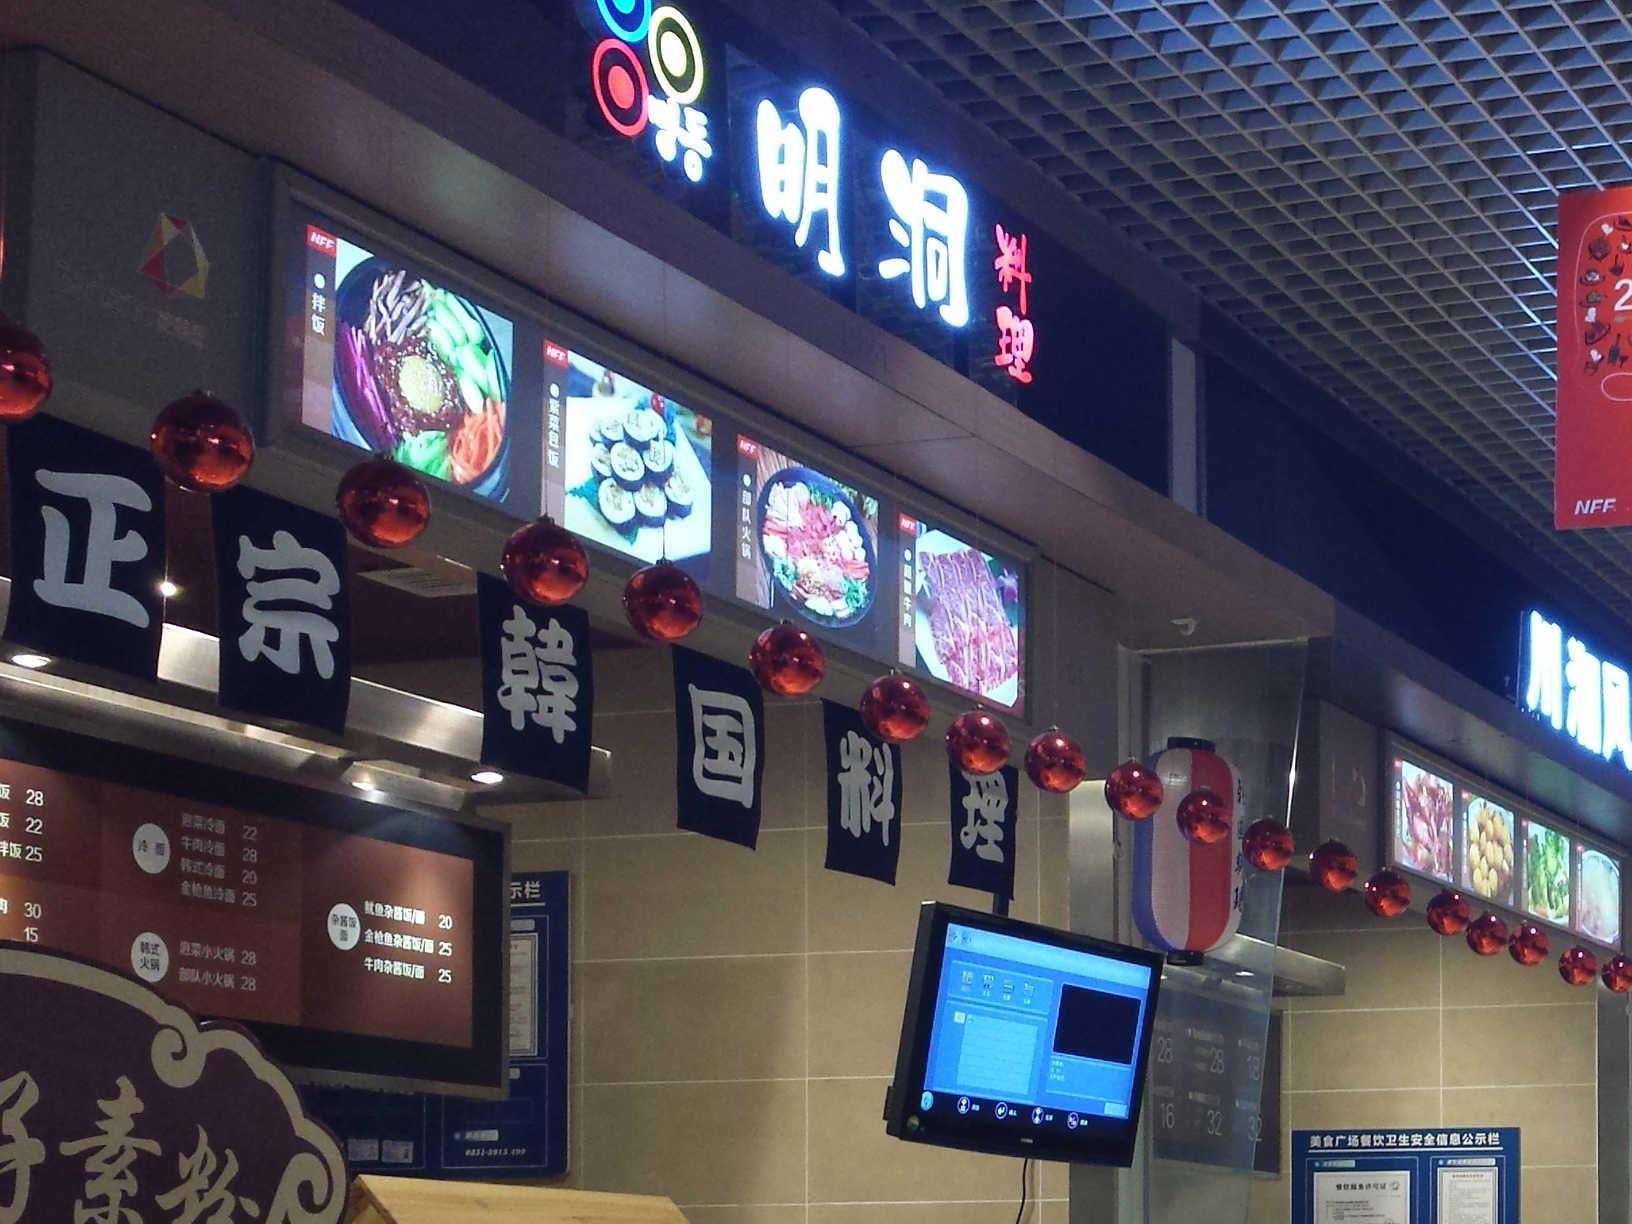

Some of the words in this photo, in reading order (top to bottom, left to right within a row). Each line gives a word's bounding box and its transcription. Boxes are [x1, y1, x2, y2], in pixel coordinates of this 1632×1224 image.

[757, 87, 970, 328] 明洞
[310, 231, 334, 251] NFF
[994, 224, 1035, 384] 料理
[311, 291, 326, 336] 拌饭
[1574, 498, 1617, 515] NFF
[26, 789, 44, 806] 28
[25, 817, 43, 835] 22
[242, 825, 257, 841] 22
[25, 846, 43, 862] 25
[242, 848, 257, 863] 28
[510, 880, 541, 899] 示栏
[242, 892, 257, 907] 25
[24, 902, 41, 919] 30
[438, 914, 453, 930] 20
[24, 927, 39, 943] 15
[241, 949, 257, 966] 28
[438, 941, 453, 957] 25
[241, 975, 257, 992] 28
[438, 968, 453, 984] 25
[1160, 1103, 1175, 1129] 16
[1207, 1110, 1224, 1136] 32
[1310, 1132, 1500, 1149] 美食广场餐饮卫生安全信息公示栏
